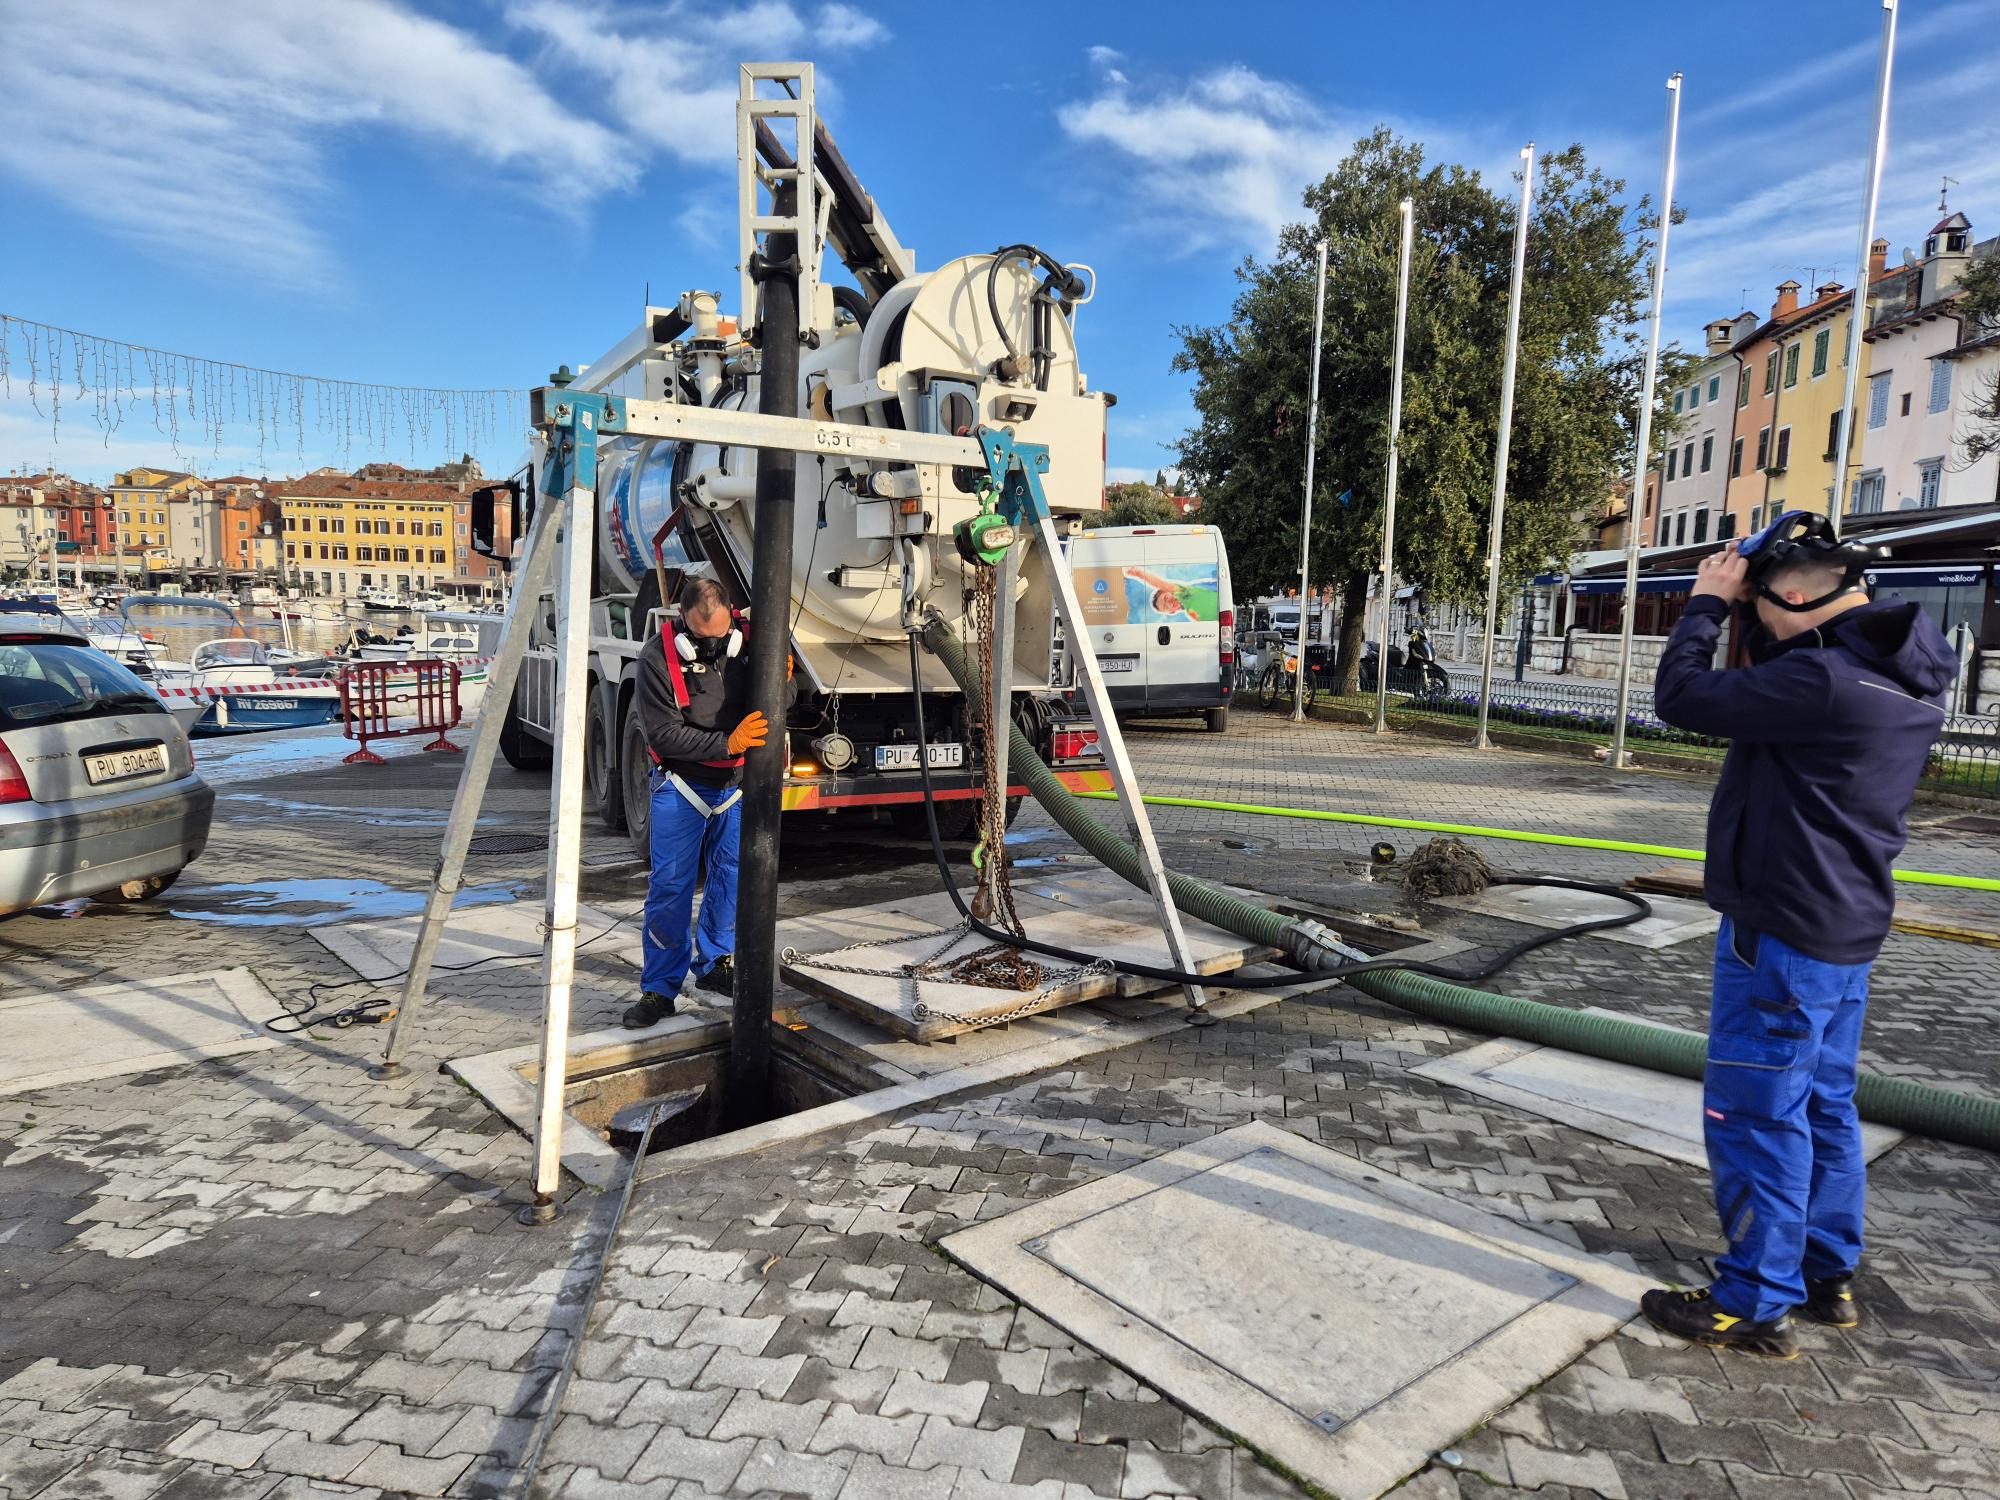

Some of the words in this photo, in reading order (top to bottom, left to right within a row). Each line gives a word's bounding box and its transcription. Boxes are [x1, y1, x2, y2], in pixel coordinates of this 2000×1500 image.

[817, 428, 840, 448] 0,5
[1938, 574, 1976, 583] wine&food
[96, 758, 115, 779] PU
[122, 750, 162, 773] 904-HR
[886, 749, 902, 764] PU
[912, 748, 959, 763] 40-TE
